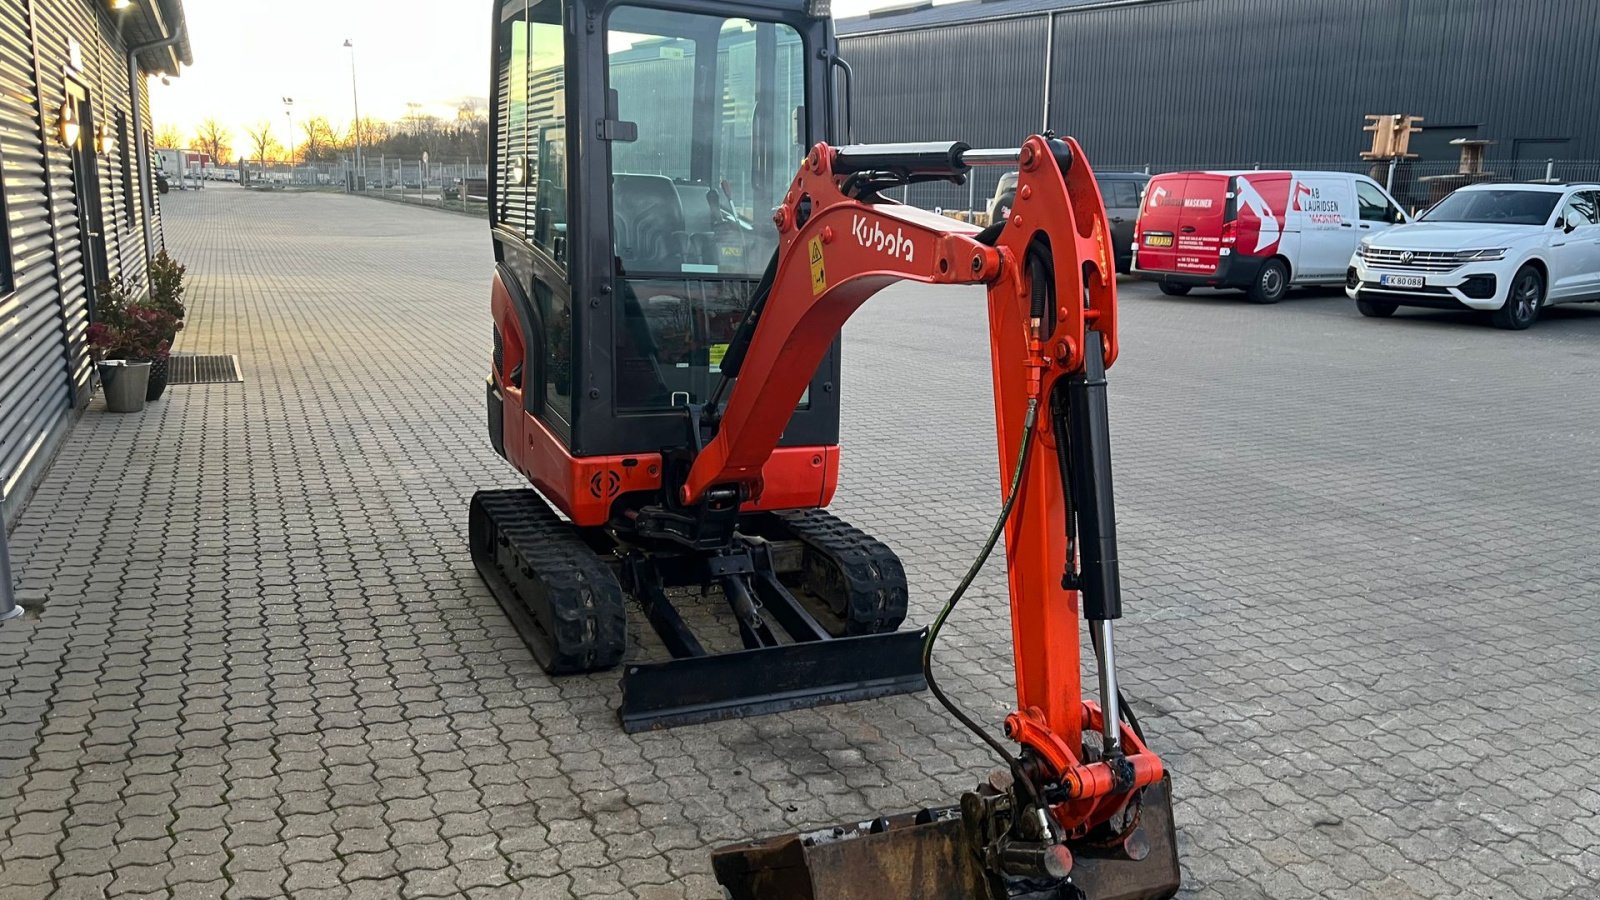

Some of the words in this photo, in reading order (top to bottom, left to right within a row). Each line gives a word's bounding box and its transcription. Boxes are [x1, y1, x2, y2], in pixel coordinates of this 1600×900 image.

[1311, 187, 1320, 199] AB
[1304, 200, 1339, 212] LAURIDSEN
[852, 214, 914, 263] Kubota
[1397, 277, 1407, 285] 80
[1408, 278, 1422, 286] 088
